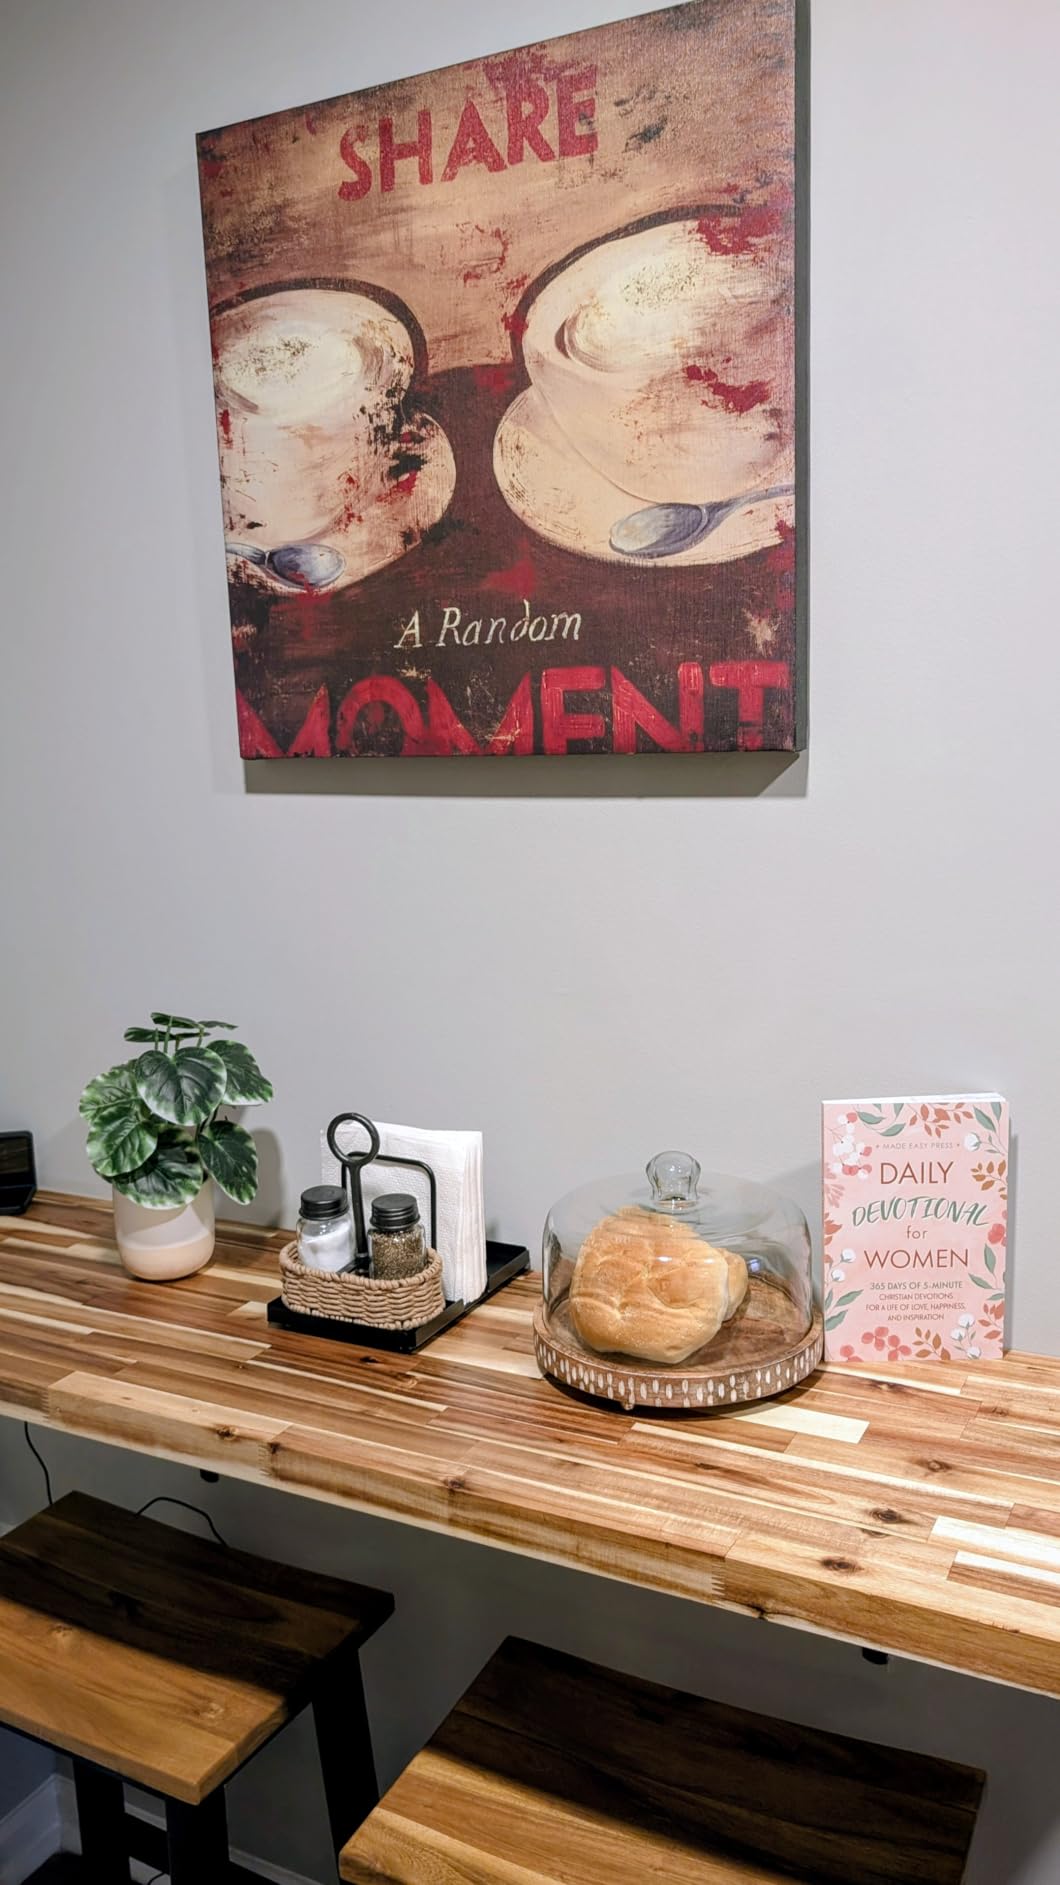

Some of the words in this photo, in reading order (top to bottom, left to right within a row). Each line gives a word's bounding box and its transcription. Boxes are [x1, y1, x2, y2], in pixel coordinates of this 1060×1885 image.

[338, 68, 598, 200] SHARE
[394, 609, 423, 649] A
[436, 600, 582, 648] Random
[237, 660, 790, 757] MOMENT
[880, 1162, 953, 1184] DAILY
[852, 1196, 989, 1226] DEVOTIONAL
[907, 1225, 928, 1239] for
[864, 1249, 968, 1268] WOMEN
[870, 1282, 885, 1290] 365
[923, 1281, 962, 1289] 5-MINUTE
